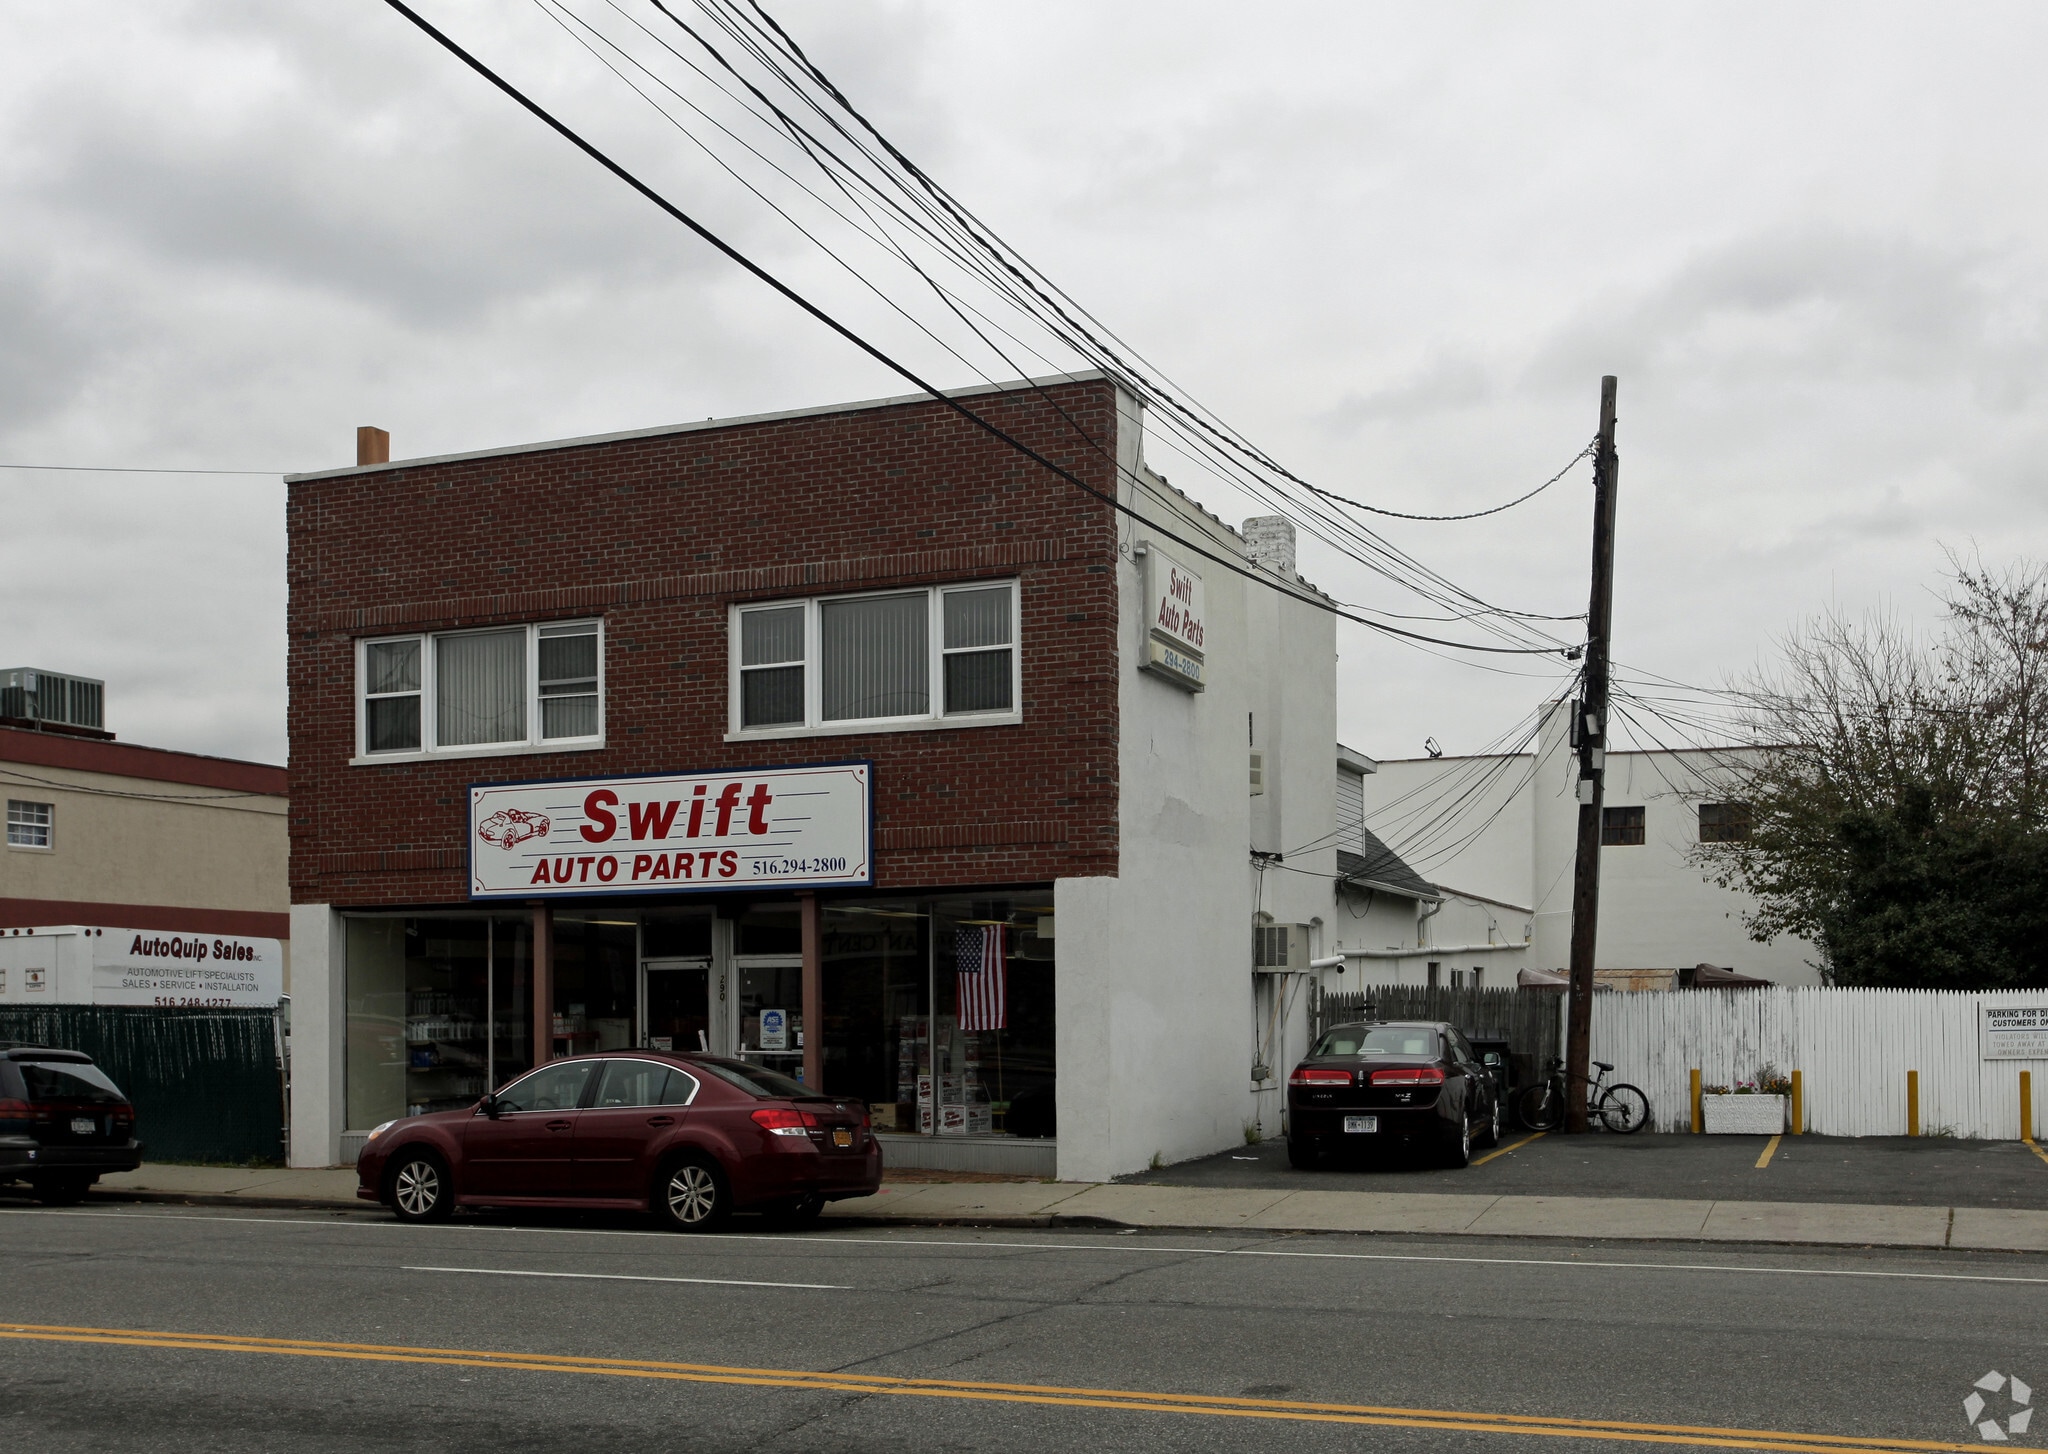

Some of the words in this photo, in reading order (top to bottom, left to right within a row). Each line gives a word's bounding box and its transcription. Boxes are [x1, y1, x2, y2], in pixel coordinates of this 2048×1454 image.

[1170, 567, 1192, 606] Swift
[1158, 596, 1180, 633] Auto
[1182, 609, 1204, 647] Parts
[1164, 649, 1200, 680] 294-2800
[579, 783, 773, 844] Swift
[530, 854, 618, 884] AUTO
[631, 850, 739, 881] PARTS
[752, 857, 847, 876] 516.294-2800
[129, 934, 208, 962] AutoQuip
[212, 939, 254, 961] Sales
[127, 967, 184, 978] AUTOMOTIVE
[185, 970, 203, 978] LIFT
[204, 970, 255, 981] SPECIALISTS
[122, 979, 151, 989] SALES
[159, 980, 196, 989] SERVICE
[204, 983, 259, 991] INSTALLATION
[766, 1016, 780, 1024] ASE
[1987, 1010, 2019, 1018] PARKING
[2022, 1010, 2037, 1018] FOR
[1992, 1018, 2037, 1027] CUSTOMERS
[1997, 1048, 2025, 1056] OWNERS
[2017, 1040, 2034, 1048] AWAY
